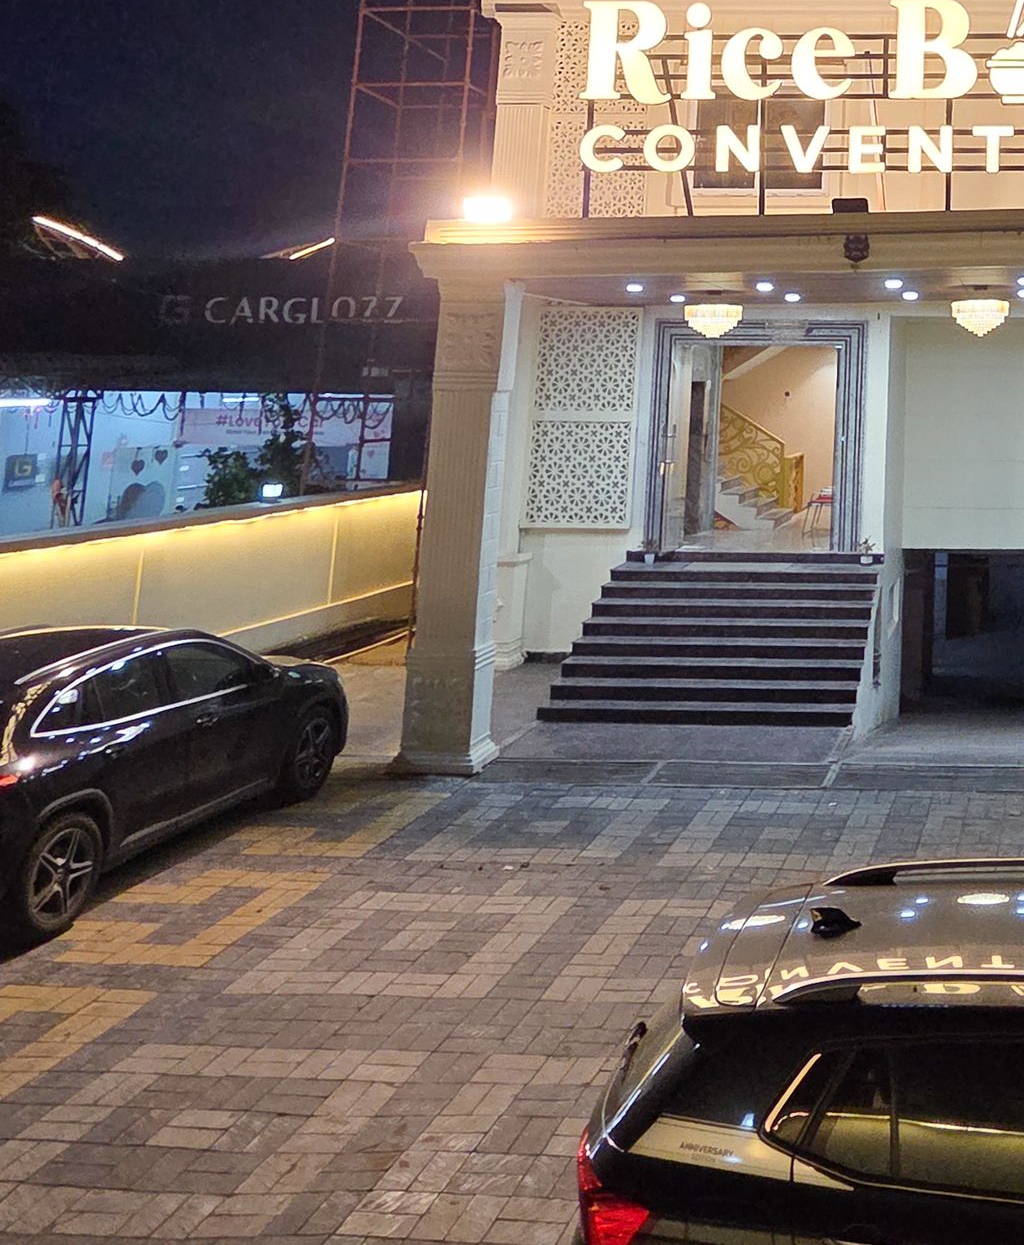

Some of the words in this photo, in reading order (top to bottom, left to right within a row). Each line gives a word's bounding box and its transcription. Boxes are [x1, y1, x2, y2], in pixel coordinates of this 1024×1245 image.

[579, 1, 856, 105] Rice
[203, 296, 404, 324] CARGLOZZ
[679, 1141, 734, 1156] ANNIVERSARY
